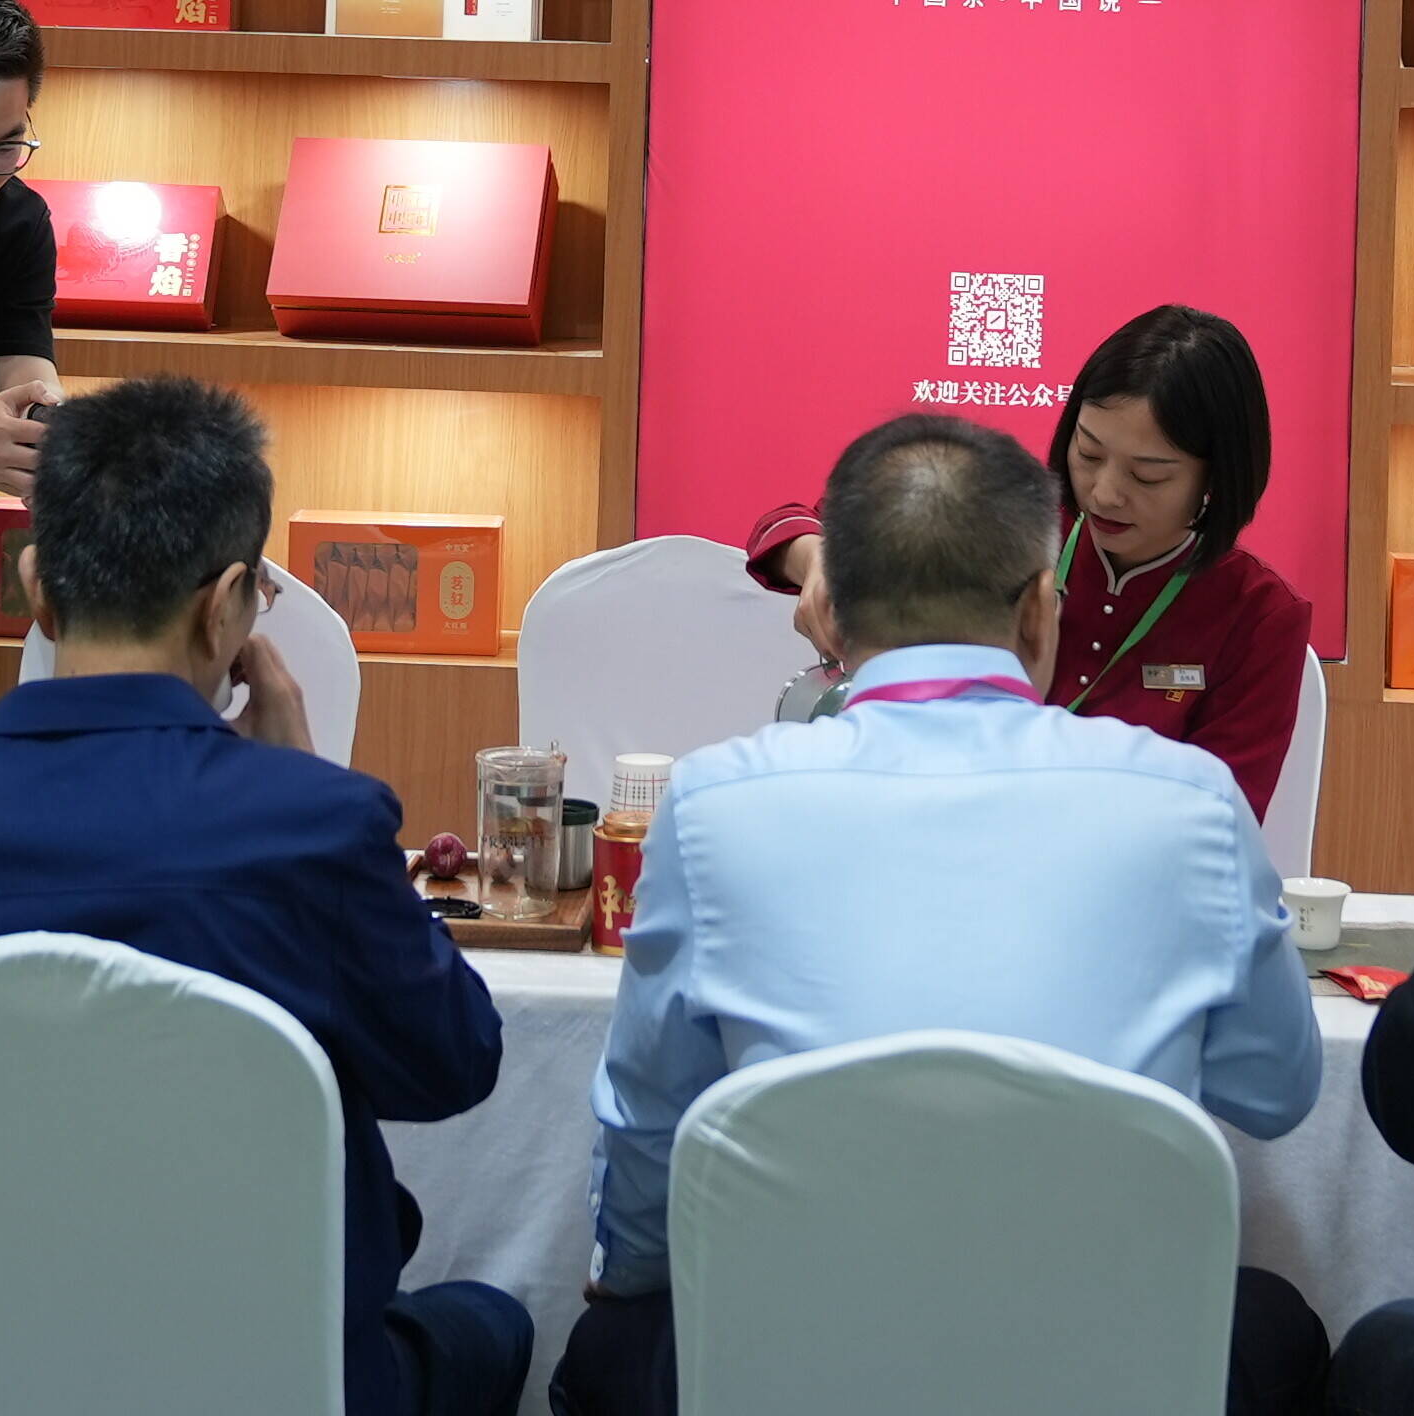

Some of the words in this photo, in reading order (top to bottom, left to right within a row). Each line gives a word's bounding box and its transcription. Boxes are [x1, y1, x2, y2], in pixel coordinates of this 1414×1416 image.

[149, 233, 189, 296] 香焰
[912, 379, 1075, 407] 欢迎关注公众号
